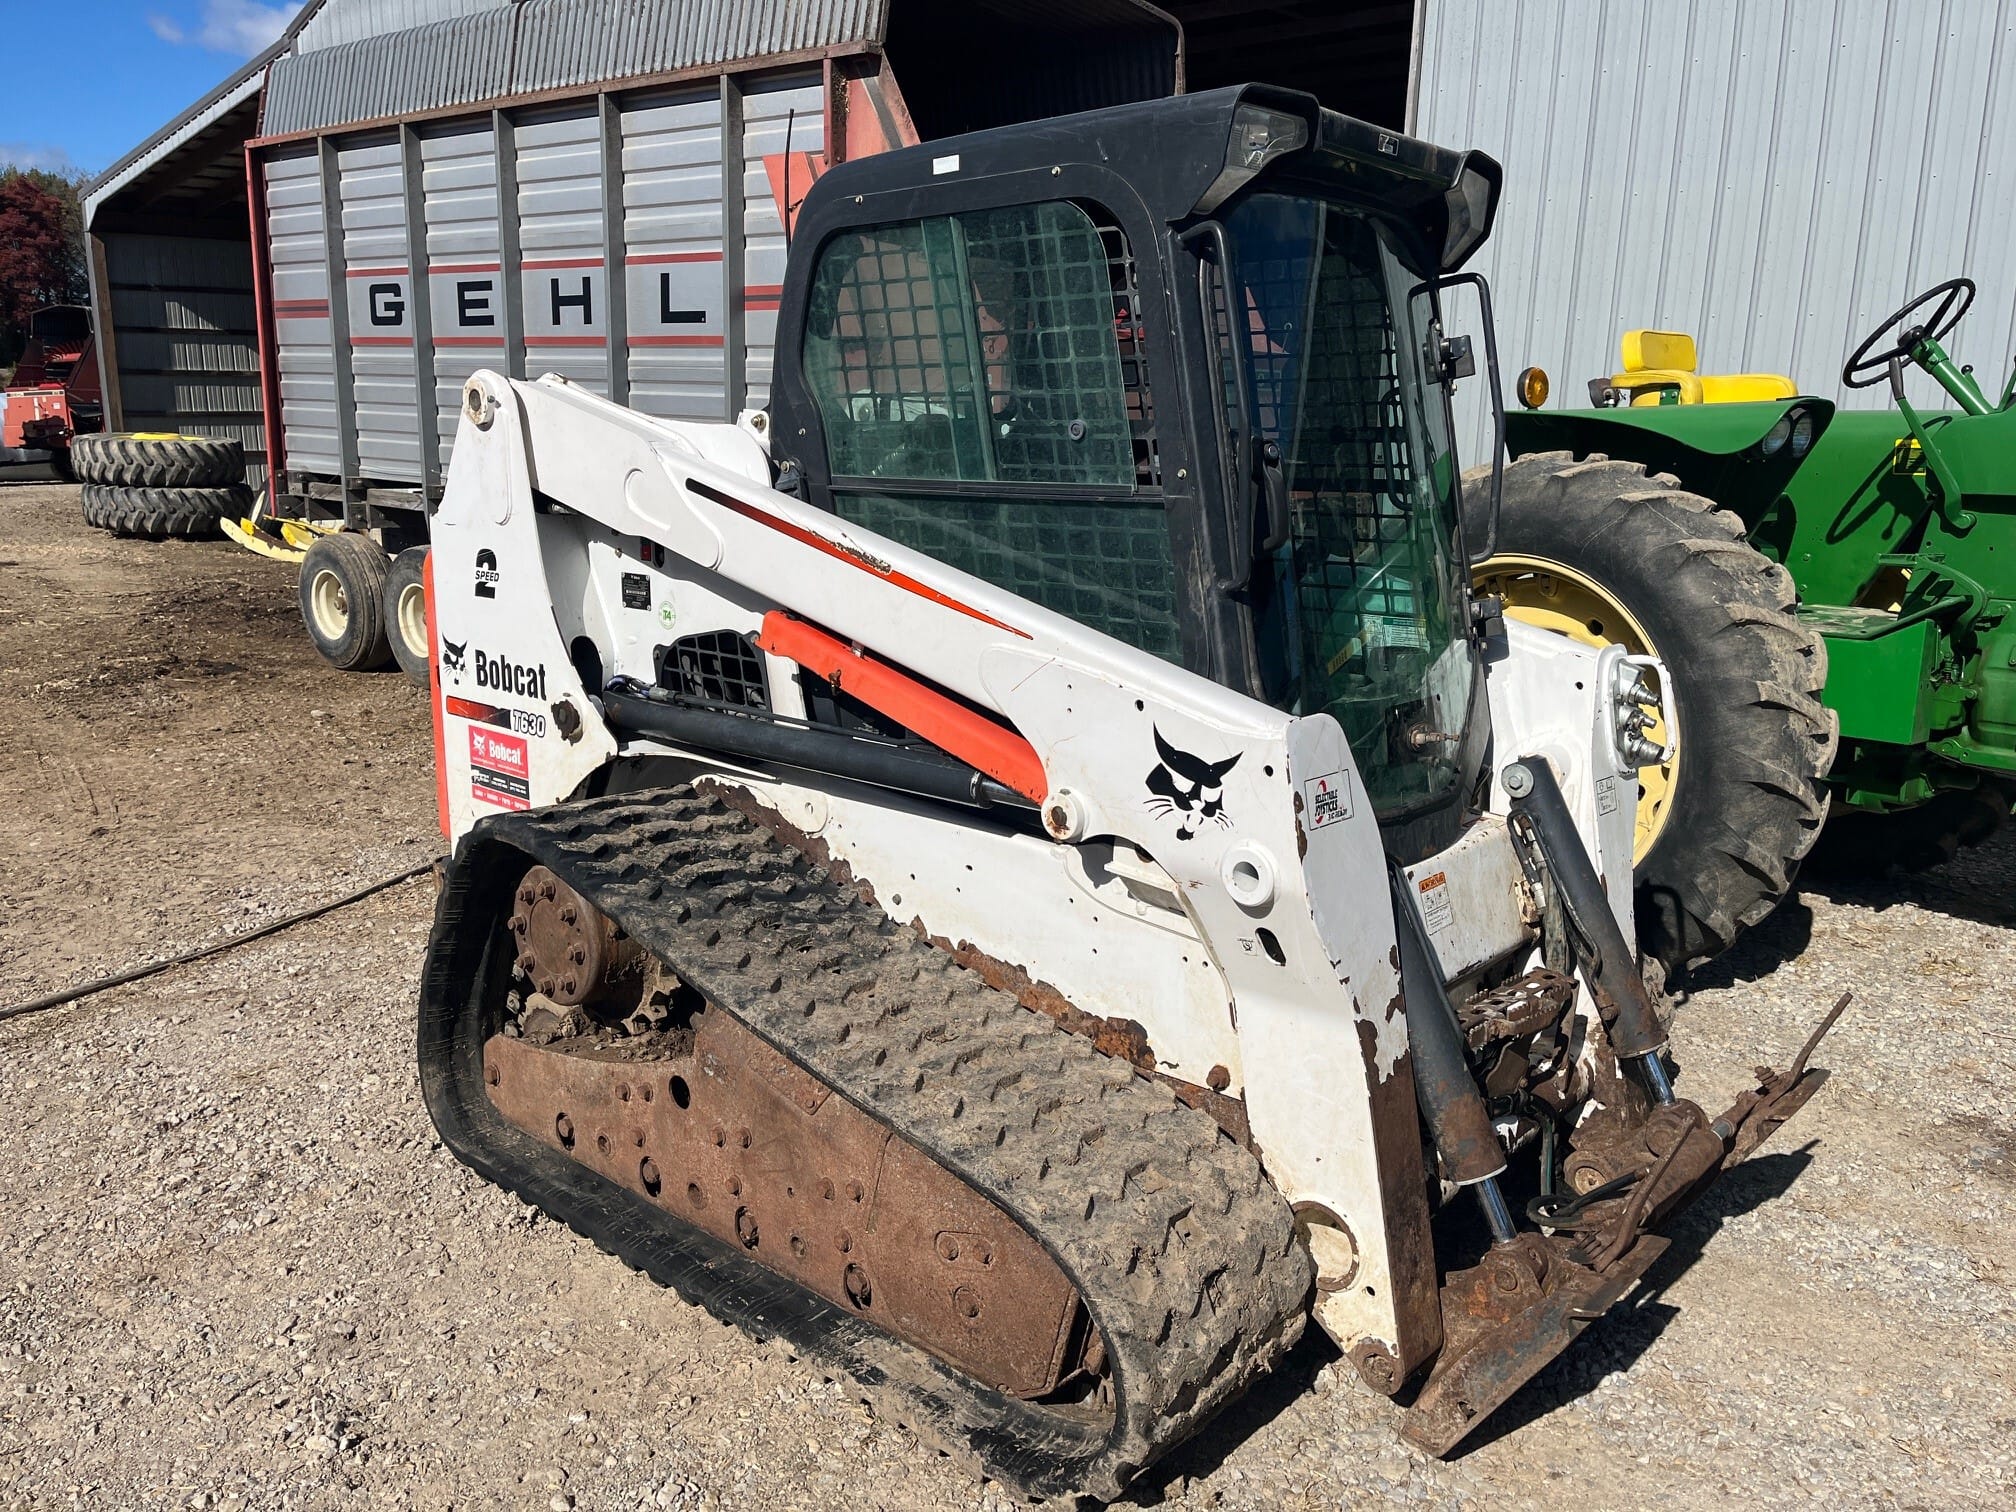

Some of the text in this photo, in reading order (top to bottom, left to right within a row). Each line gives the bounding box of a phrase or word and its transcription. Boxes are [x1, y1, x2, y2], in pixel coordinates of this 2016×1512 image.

[475, 548, 497, 599] 2
[475, 570, 499, 582] SPEED
[475, 649, 547, 701] Bobcat
[513, 709, 546, 738] T630
[488, 739, 522, 766] Bobcat
